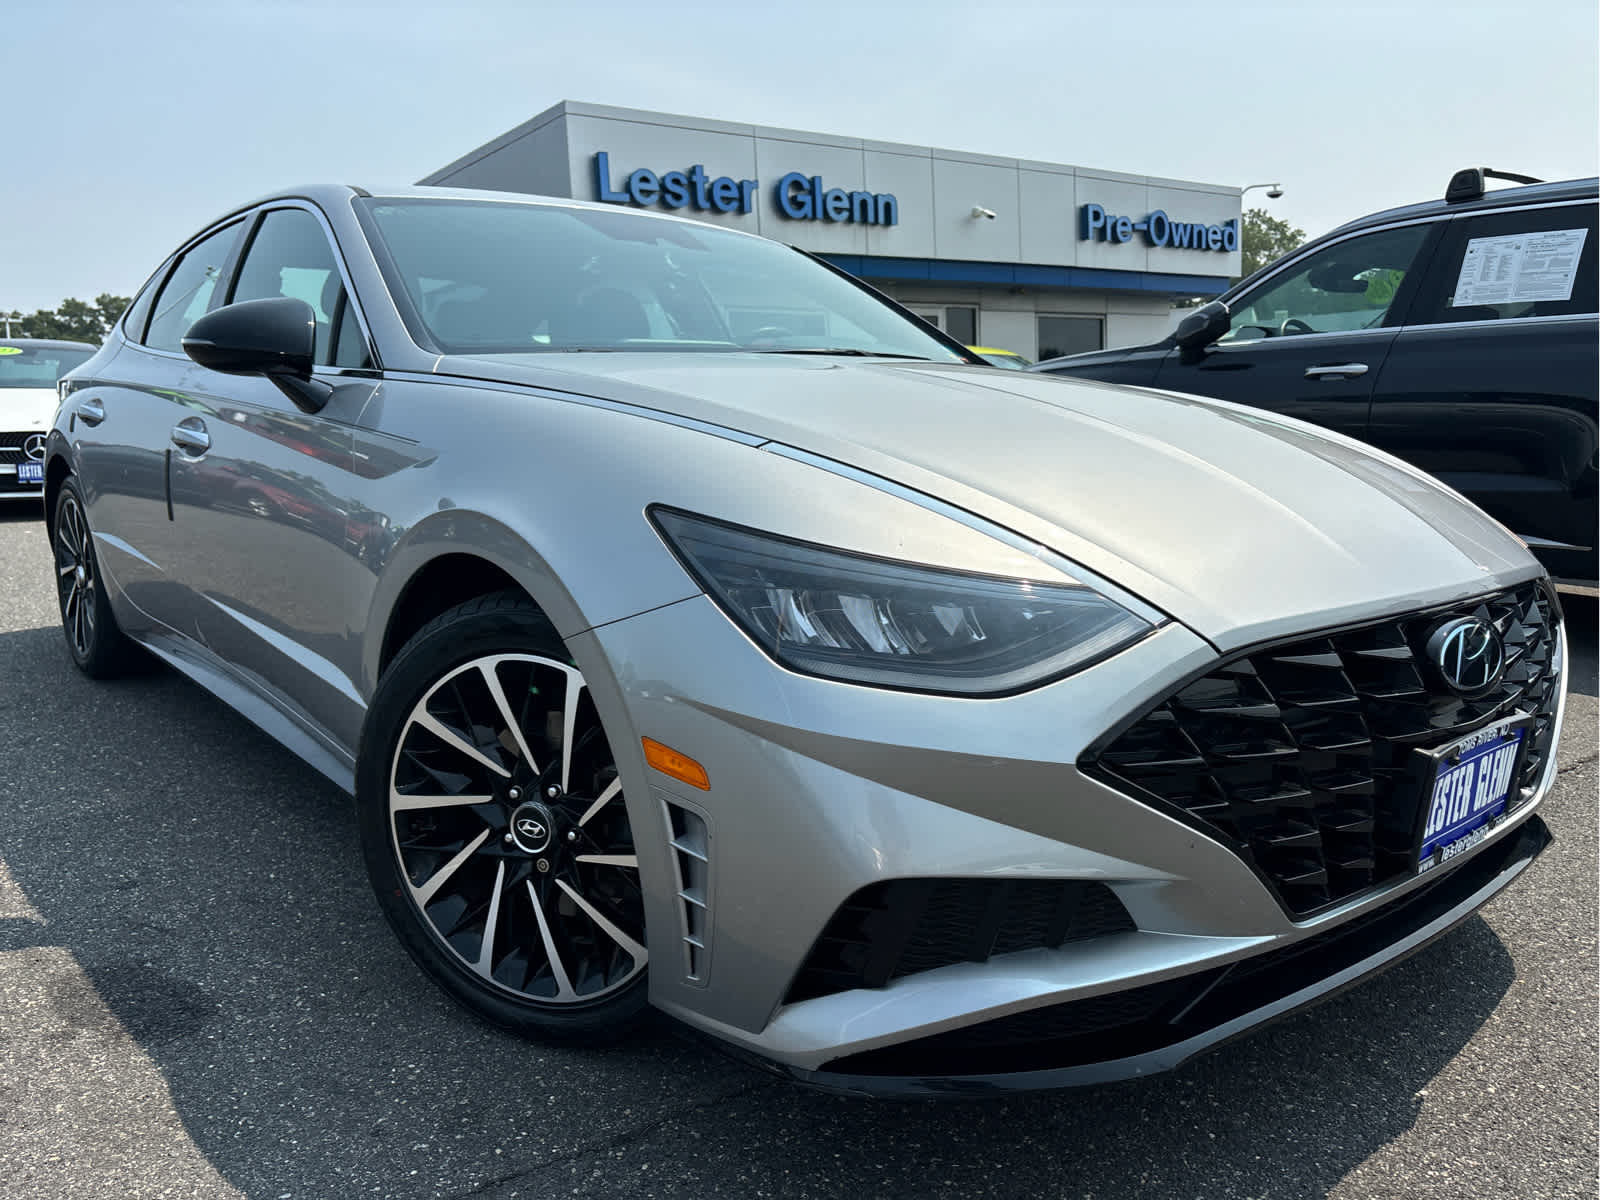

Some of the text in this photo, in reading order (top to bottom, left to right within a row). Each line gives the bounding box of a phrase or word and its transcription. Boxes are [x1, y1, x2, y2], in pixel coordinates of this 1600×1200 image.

[594, 151, 898, 226] Lester Glenn
[1081, 203, 1239, 252] Pre-Owned
[1473, 742, 1519, 812] GLENN
